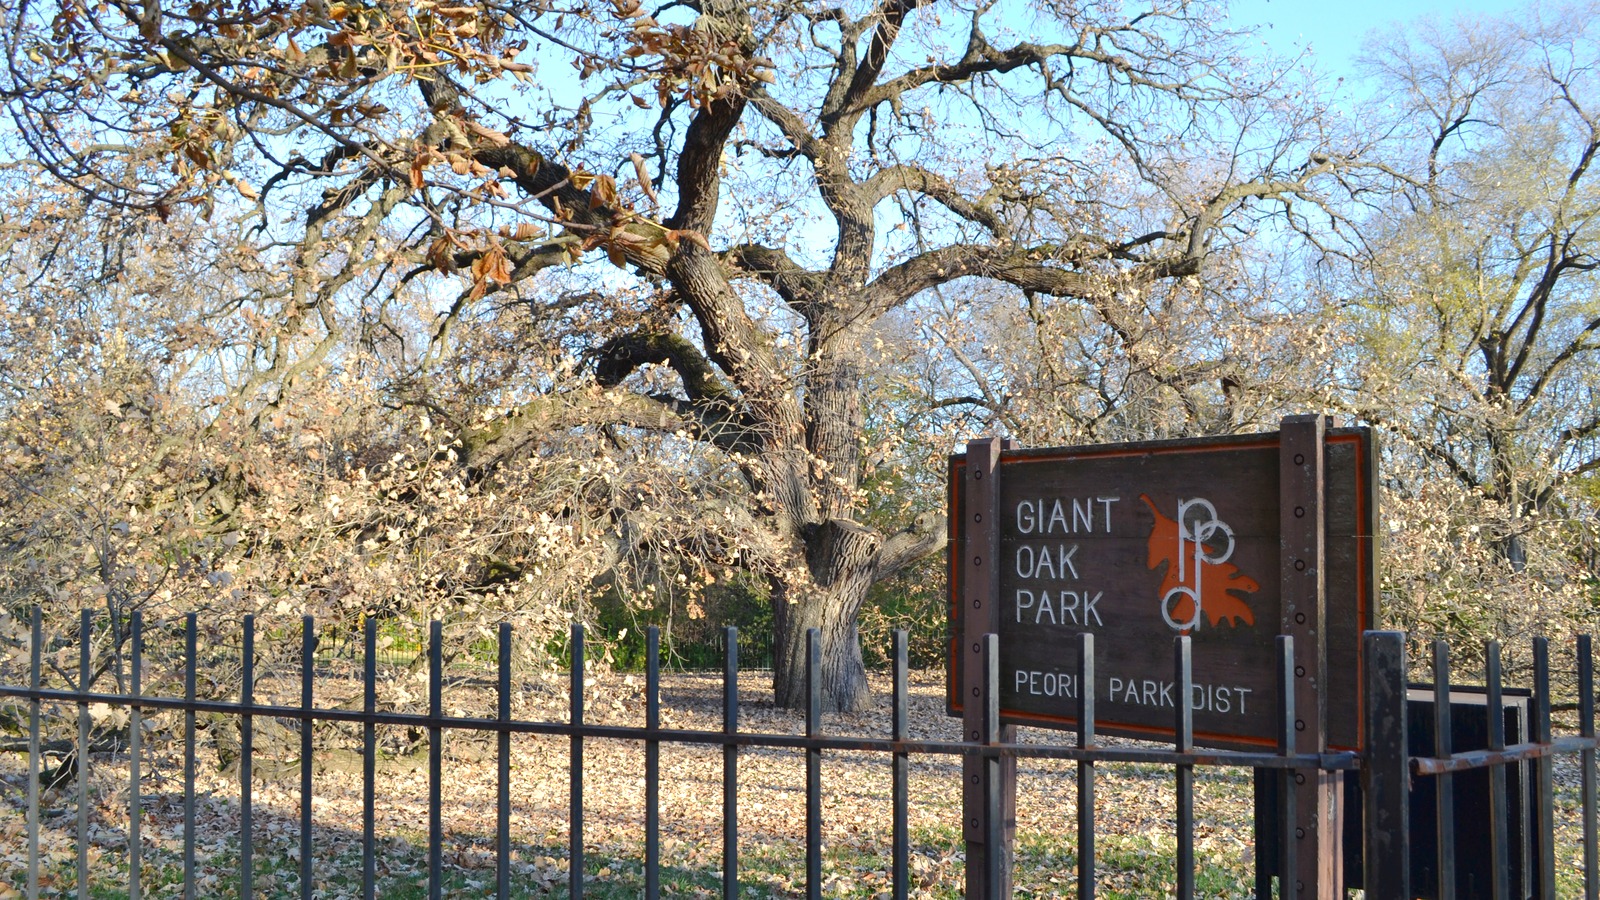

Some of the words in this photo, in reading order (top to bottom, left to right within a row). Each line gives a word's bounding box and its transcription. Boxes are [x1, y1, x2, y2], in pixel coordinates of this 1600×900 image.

[1016, 497, 1120, 534] GIANT
[1016, 544, 1079, 579] OAK
[1016, 589, 1104, 627] PARK
[1015, 670, 1078, 699] PEORI
[1109, 677, 1175, 708] PARK
[1191, 683, 1252, 715] DIST
